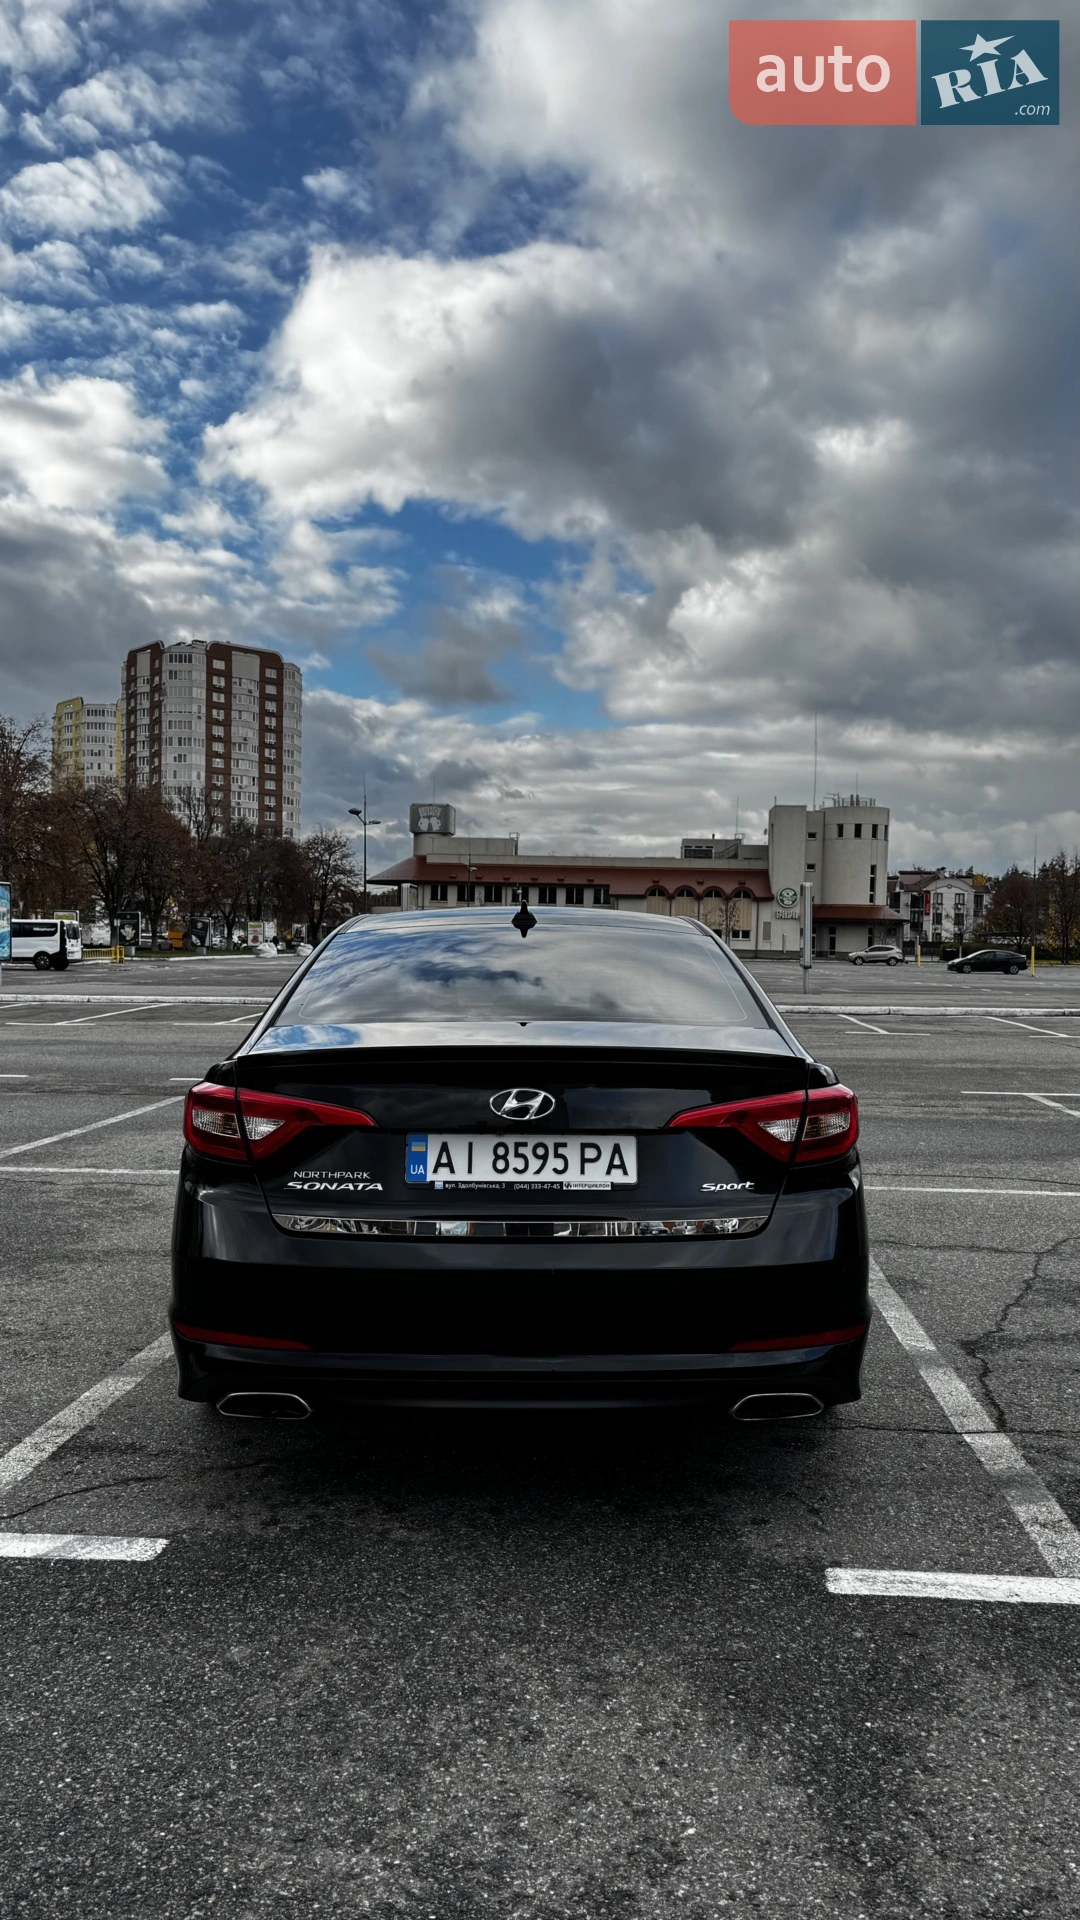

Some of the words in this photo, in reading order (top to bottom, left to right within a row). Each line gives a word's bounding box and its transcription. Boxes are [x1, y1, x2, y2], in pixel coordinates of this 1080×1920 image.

[491, 1141, 569, 1175] 8595
[579, 1142, 629, 1176] PA
[293, 1170, 371, 1180] NORTHPARK
[410, 1164, 425, 1175] UA
[283, 1181, 384, 1191] SONATA
[700, 1181, 755, 1193] Sport
